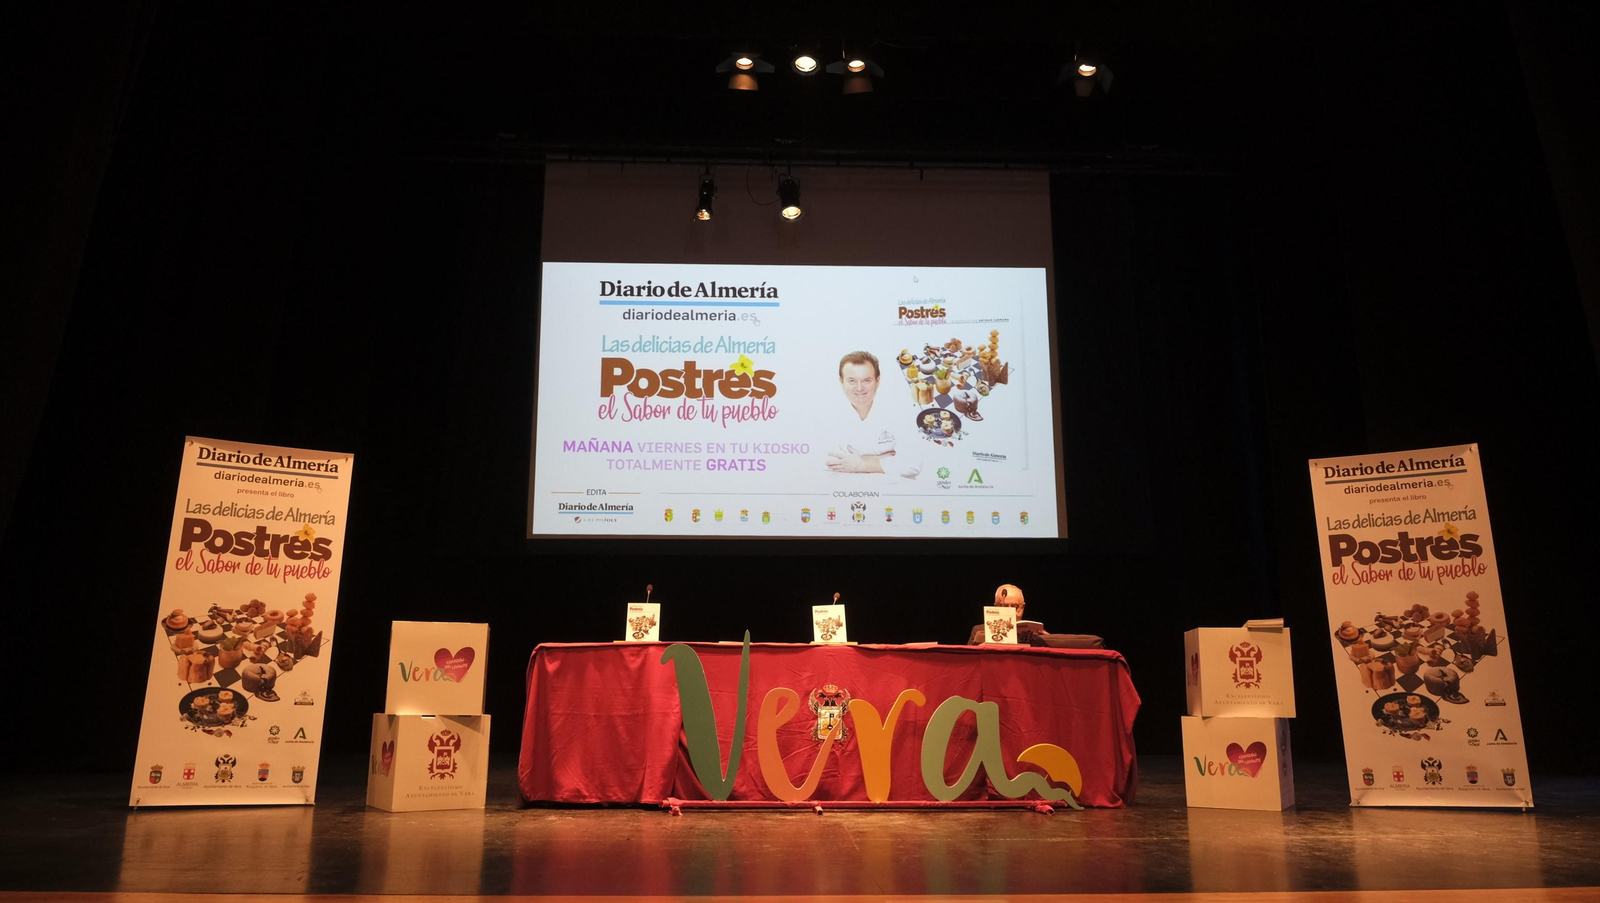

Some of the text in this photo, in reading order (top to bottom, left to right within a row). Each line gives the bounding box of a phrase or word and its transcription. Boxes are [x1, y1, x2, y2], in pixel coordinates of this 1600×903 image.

[599, 280, 779, 299] Diario de Almería
[622, 309, 757, 322] diariodealmeria.es
[898, 306, 946, 319] Postres
[601, 335, 776, 355] Las delicias de Almería
[600, 357, 778, 399] Postres
[598, 392, 779, 428] el Sabor de tu pueblo
[562, 438, 810, 455] MAÑANA VIERNES EN TU KIOSKO
[197, 447, 339, 473] Diario de Almería
[607, 458, 767, 471] TOTALMENTE GRATIS
[1323, 454, 1466, 479] Diario de Almería
[214, 470, 321, 490] diariodealmeria.es
[1344, 478, 1451, 495] diariodealmeria.es
[237, 487, 269, 497] presenta
[1369, 496, 1400, 505] presenta
[1410, 493, 1427, 501] libro
[185, 498, 336, 526] Las delicias de Almería
[558, 502, 634, 511] Diario de Almería
[1326, 505, 1477, 531] Las delicias de Almería
[179, 517, 333, 562] Postres
[1328, 531, 1483, 567] Postres
[175, 548, 332, 584] el Sabor de tu pueblo
[1332, 555, 1488, 586] el Sabor de tu pueblo
[399, 660, 449, 683] Vera
[661, 629, 1084, 811] Vera
[1193, 755, 1243, 777] Vera
